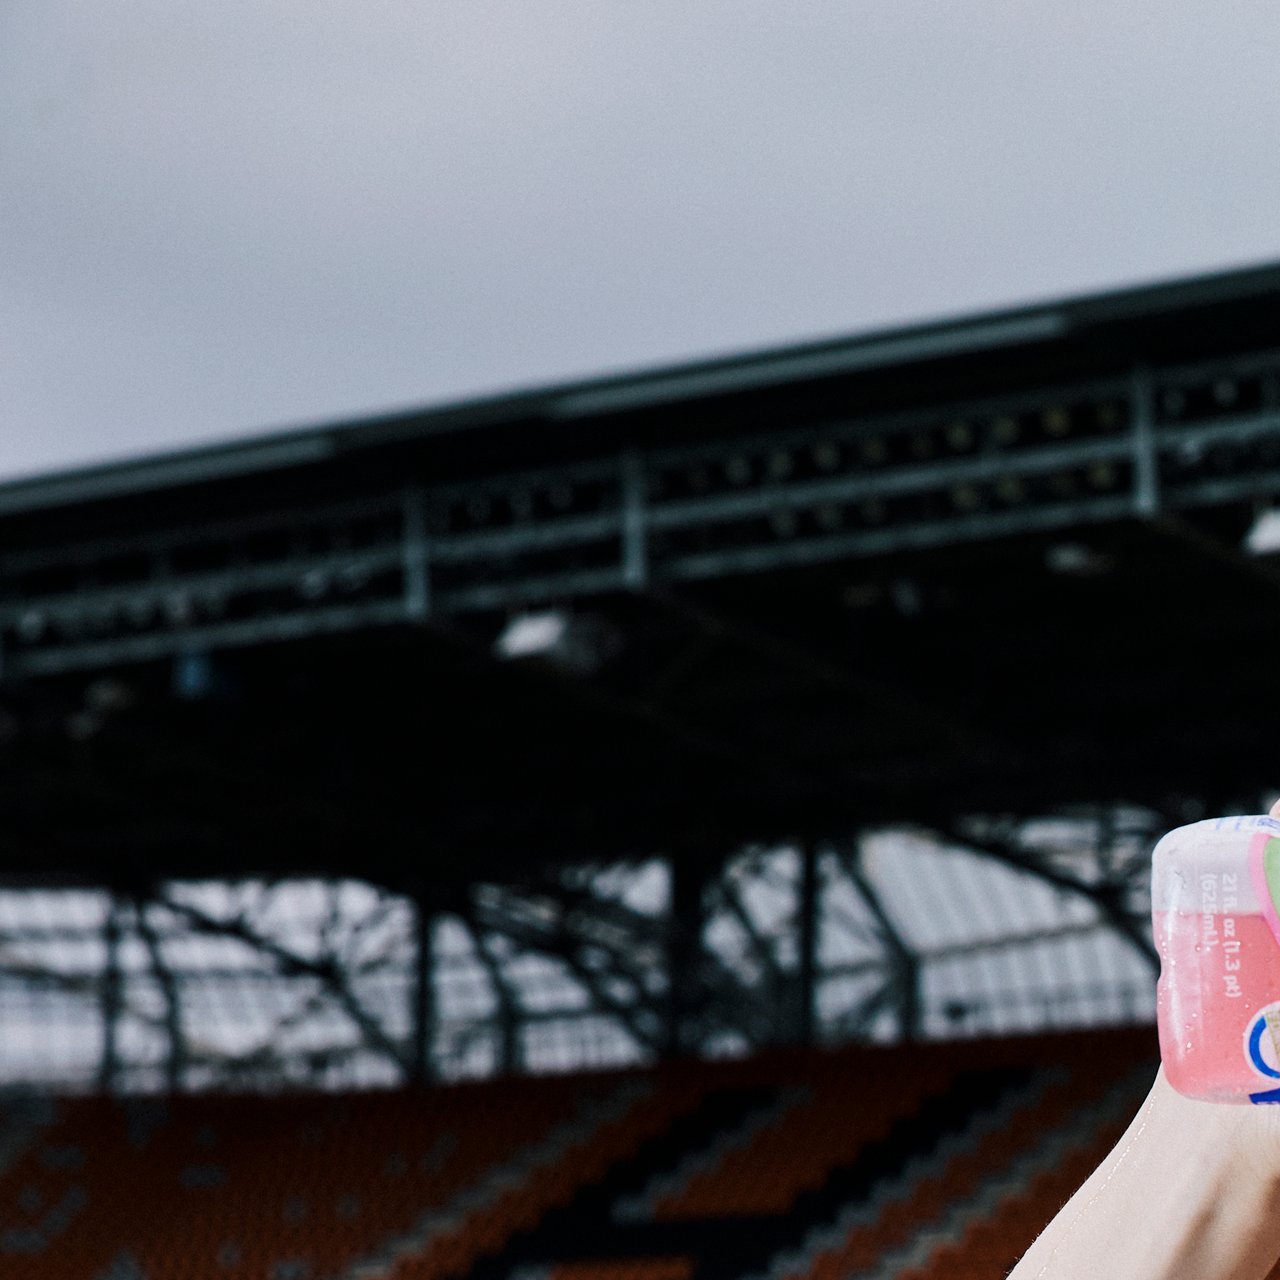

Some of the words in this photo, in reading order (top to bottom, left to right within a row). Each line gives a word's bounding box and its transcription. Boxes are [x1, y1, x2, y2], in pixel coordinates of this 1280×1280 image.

[1222, 874, 1238, 892] 21
[1224, 918, 1236, 937] oz
[1222, 941, 1240, 971] (1.3
[1222, 975, 1242, 998] pt)
